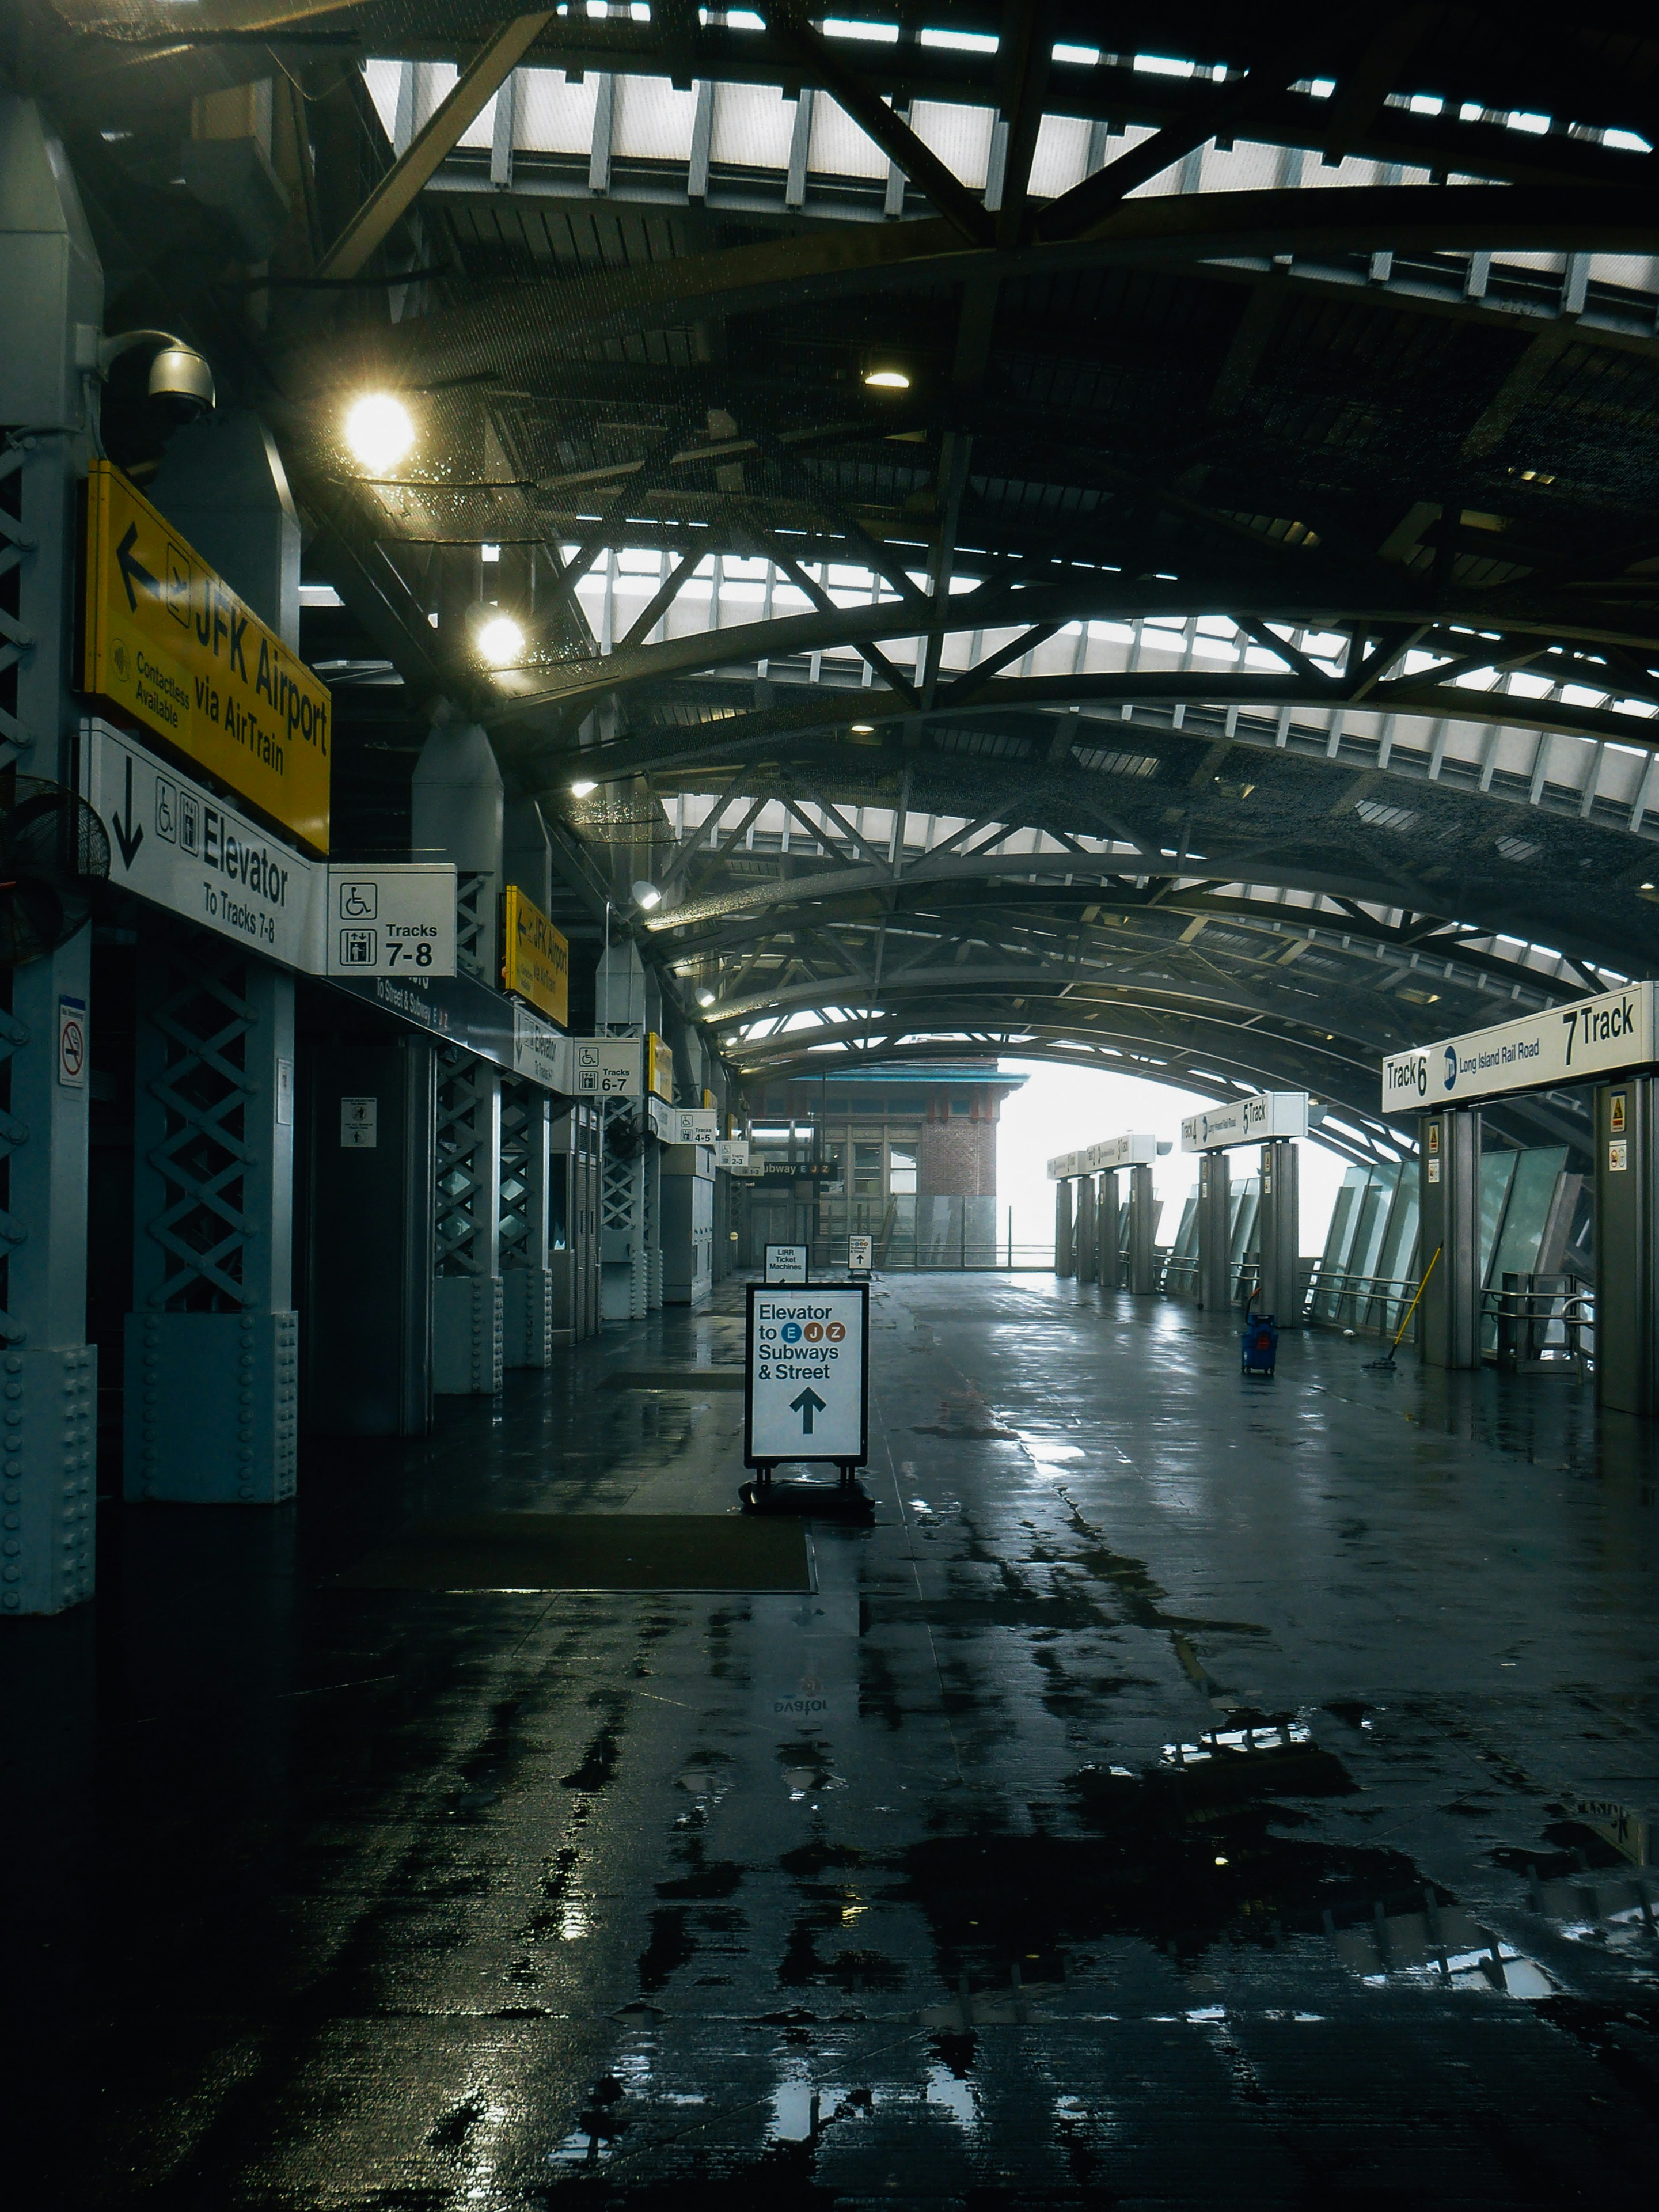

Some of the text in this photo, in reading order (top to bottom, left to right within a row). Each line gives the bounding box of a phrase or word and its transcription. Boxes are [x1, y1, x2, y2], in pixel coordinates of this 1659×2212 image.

[136, 651, 190, 711] Contactless
[196, 580, 327, 756] JFK Airport
[136, 680, 179, 729] Available
[194, 675, 283, 776] via AirTrain
[204, 806, 288, 907] Elevator
[203, 881, 275, 944] To Tracks 7-8
[385, 924, 438, 938] Tracks
[534, 916, 567, 976] JFK Airport
[385, 942, 433, 967] 7-8
[376, 977, 384, 999] To
[385, 980, 403, 1008] Street
[404, 990, 409, 1011] &
[409, 992, 431, 1026] Subway
[1387, 1057, 1417, 1090] Track
[1417, 1055, 1428, 1097] 6
[1459, 1056, 1476, 1075] Long
[1478, 1049, 1499, 1069] Island
[1502, 1046, 1516, 1065] Rail
[1518, 1037, 1539, 1061] Road
[1562, 1010, 1578, 1067] 7
[1580, 996, 1634, 1045] Track
[602, 1078, 627, 1092] 6-7
[603, 1068, 630, 1076] Tracks
[694, 1133, 711, 1142] 4-5
[1181, 1120, 1193, 1140] Track
[1193, 1118, 1197, 1145] 4
[1243, 1103, 1248, 1135] 5
[1249, 1099, 1266, 1123] Track
[764, 1164, 796, 1175] ubway
[760, 1304, 832, 1320] Elevator
[759, 1325, 840, 1340] to E J Z
[758, 1344, 839, 1363] Subways
[758, 1363, 830, 1380] & Street
